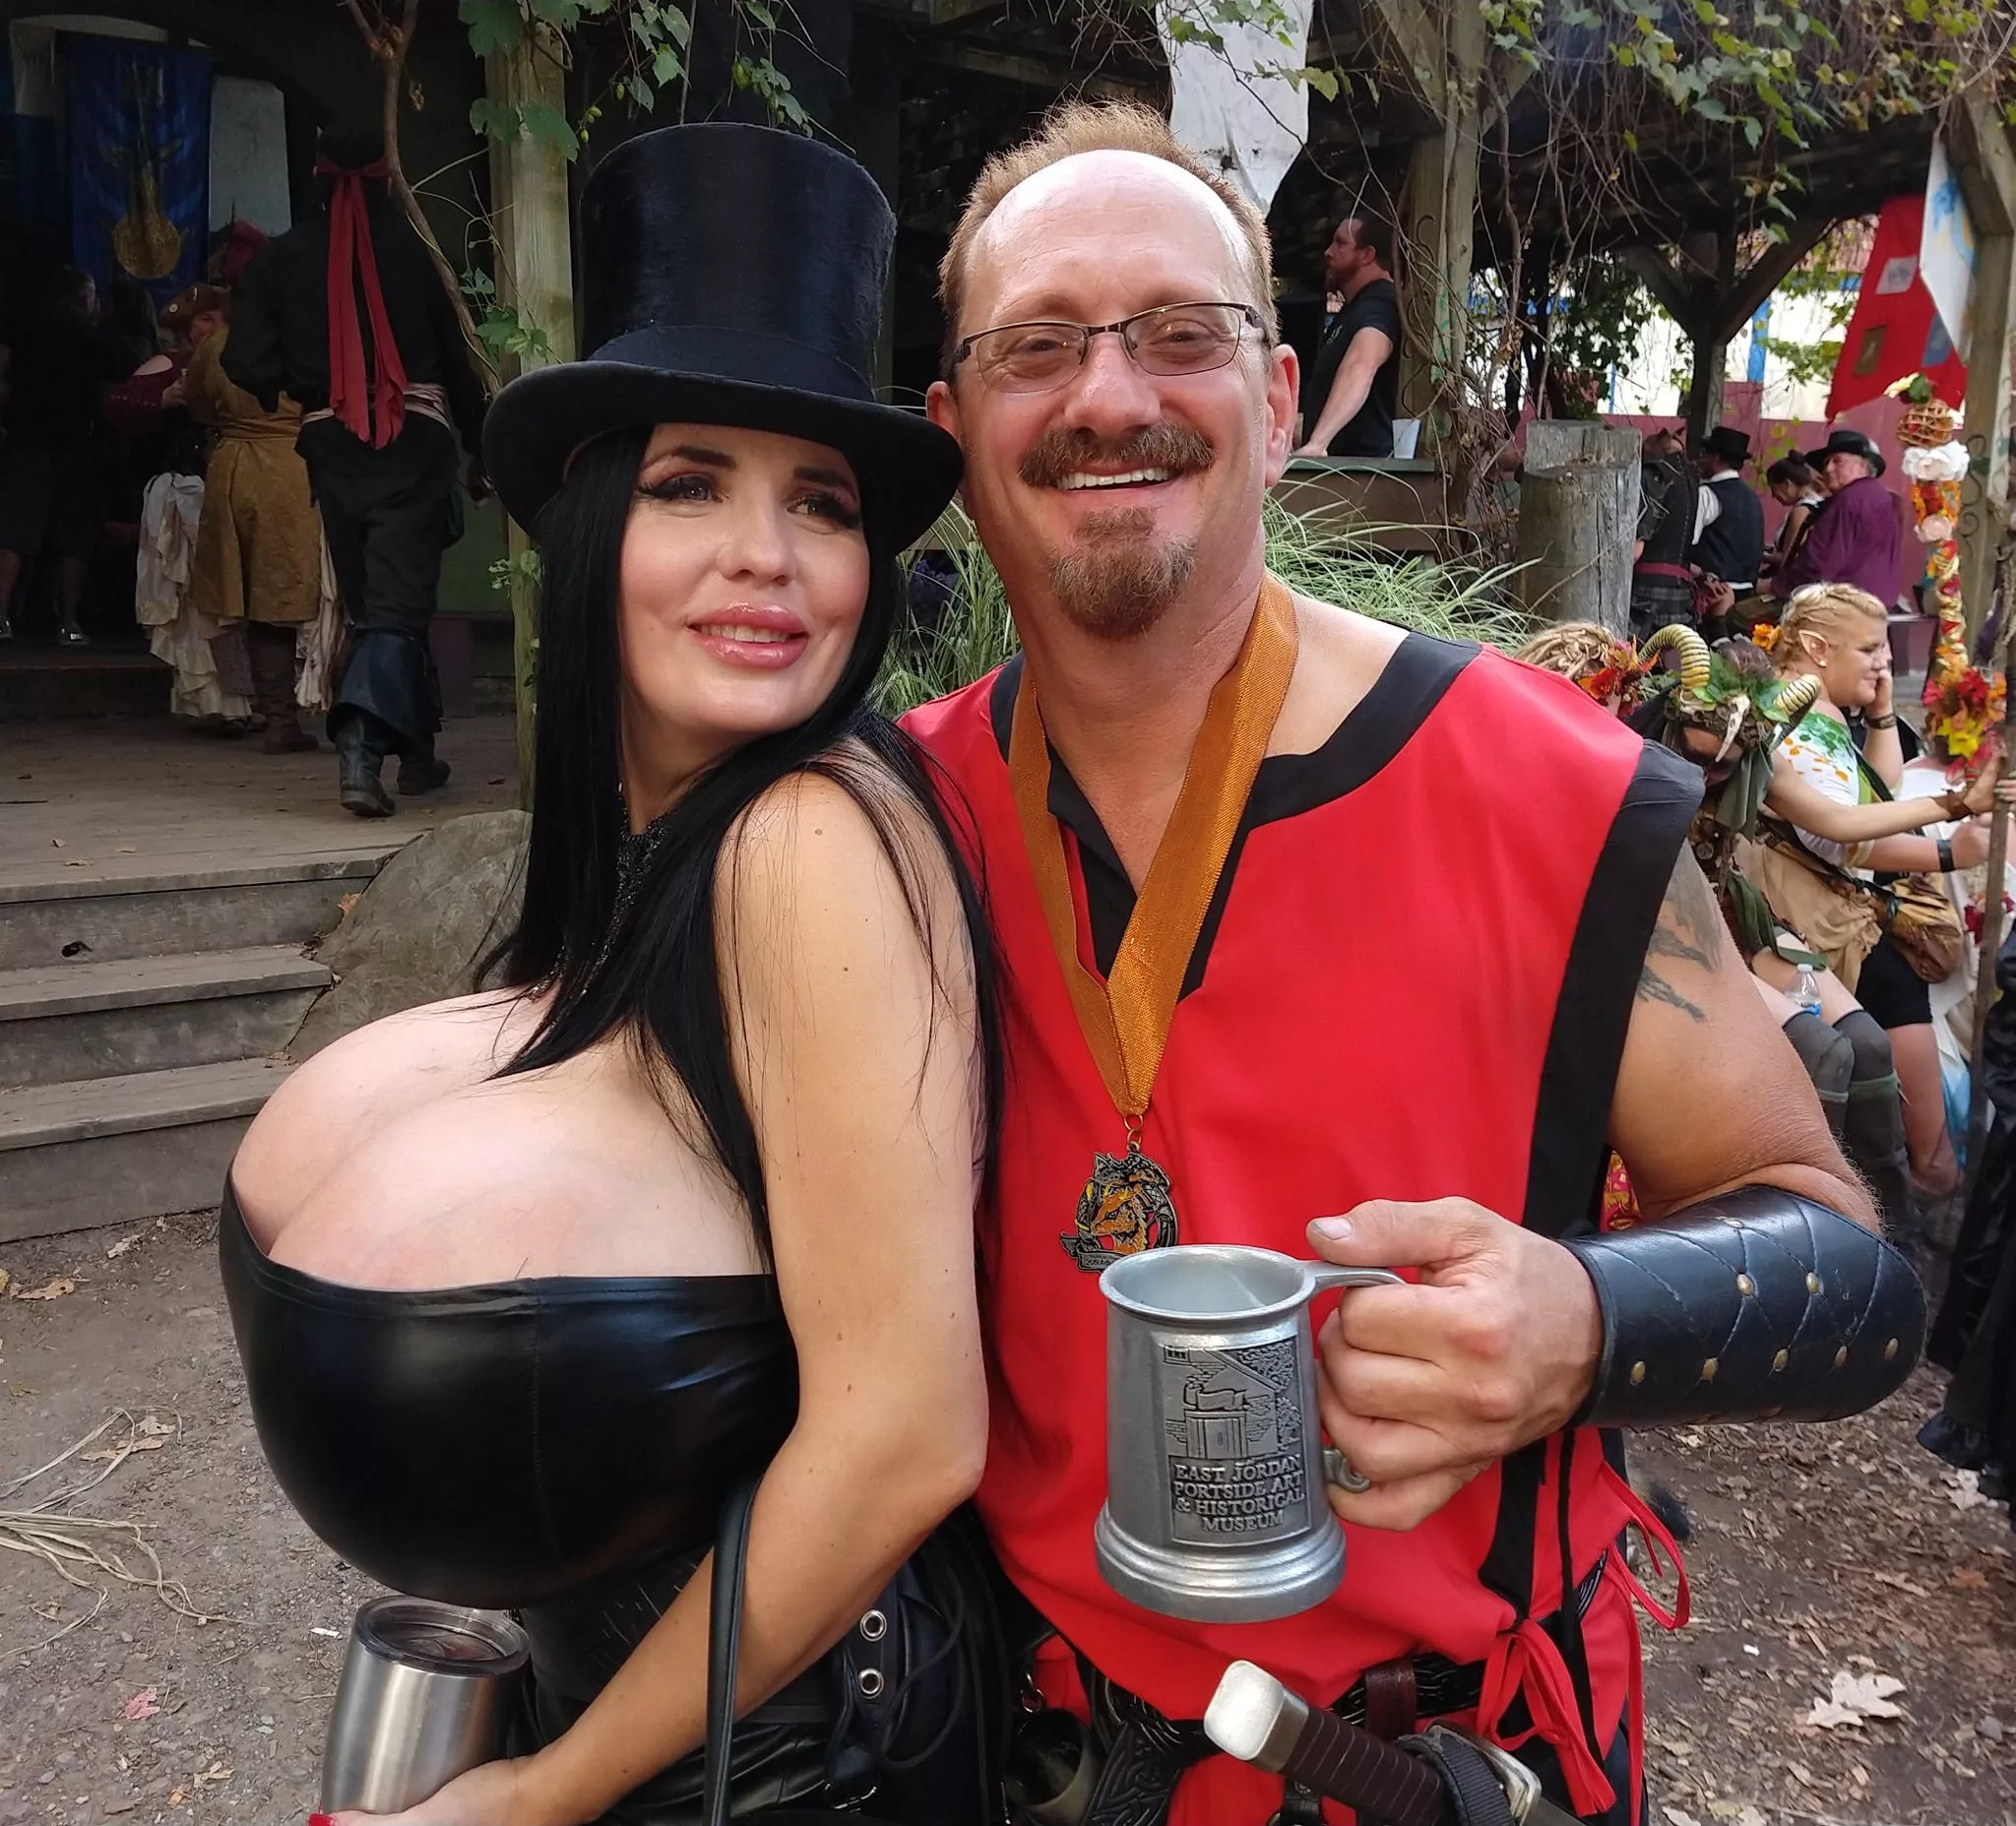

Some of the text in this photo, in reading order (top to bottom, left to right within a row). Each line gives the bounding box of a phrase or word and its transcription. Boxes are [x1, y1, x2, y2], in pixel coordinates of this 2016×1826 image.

[1173, 1454, 1301, 1482] EAST JORDAN
[1172, 1470, 1303, 1499] PORTSIDE ART
[1174, 1488, 1305, 1516] & HISTORICAL
[1201, 1509, 1285, 1533] MUSEUM
